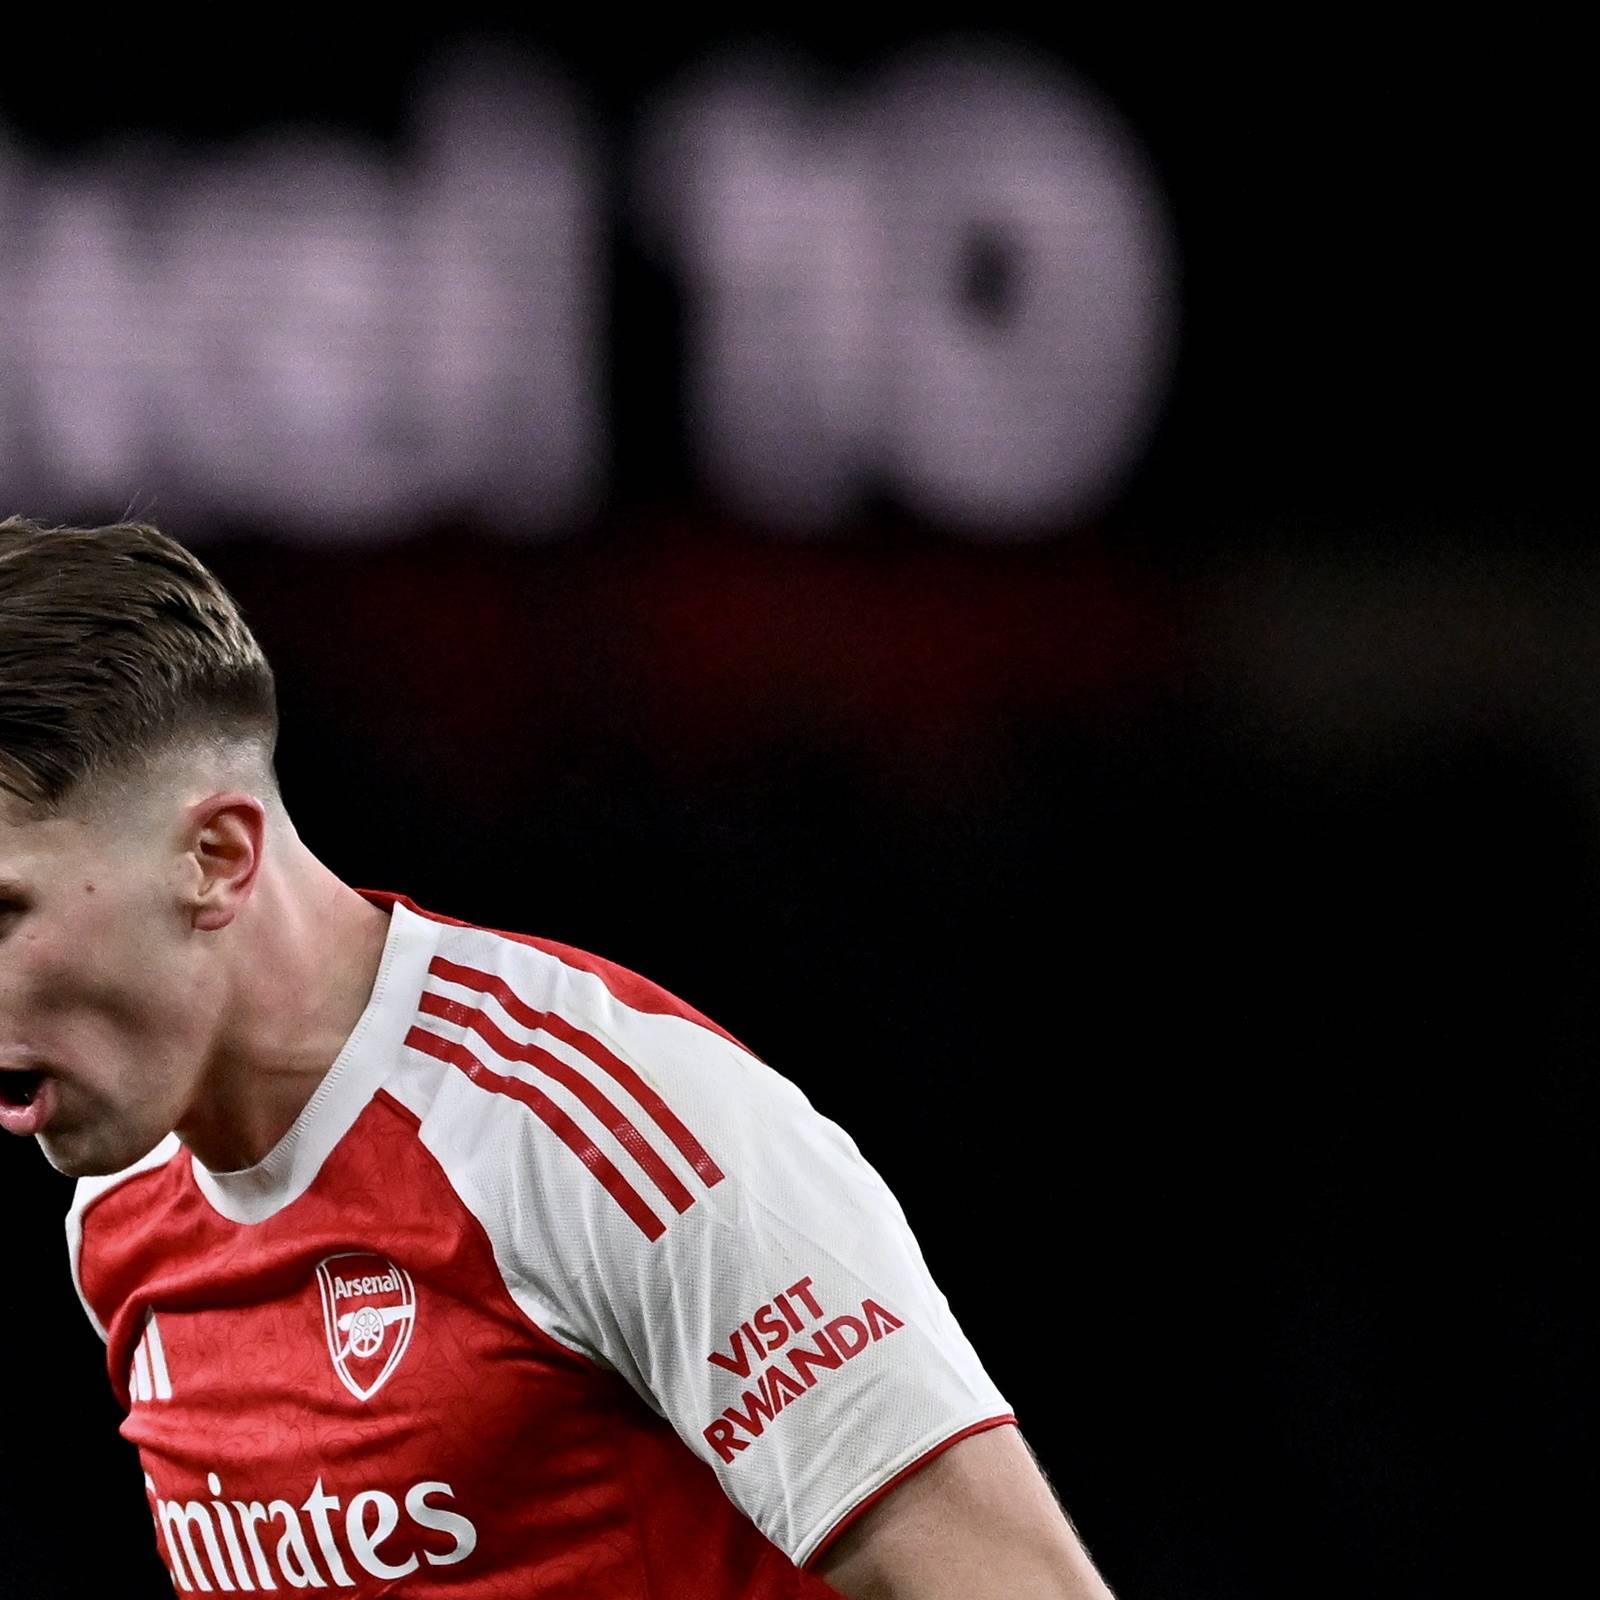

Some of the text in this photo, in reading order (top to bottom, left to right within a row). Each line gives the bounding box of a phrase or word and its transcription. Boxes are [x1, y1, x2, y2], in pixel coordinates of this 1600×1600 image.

[334, 1268, 400, 1300] Arsenal
[706, 1275, 825, 1379] VISIT
[702, 1298, 906, 1465] RWANDA
[144, 1472, 478, 1593] mirates
